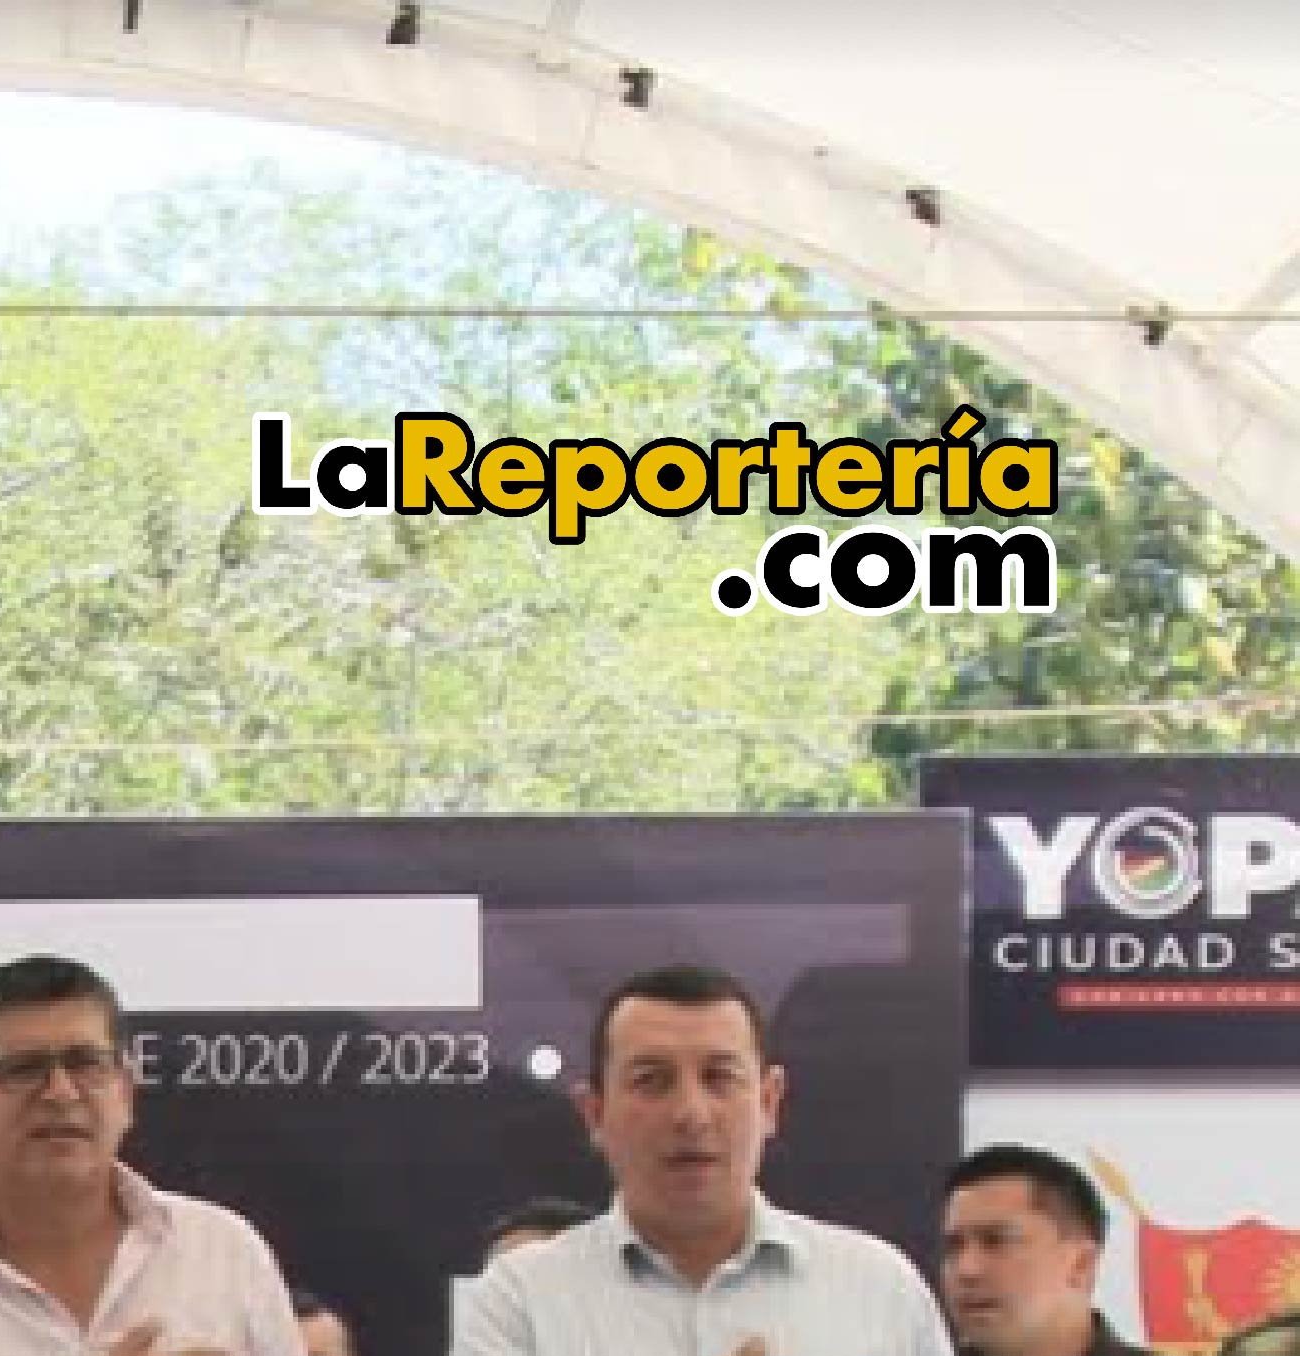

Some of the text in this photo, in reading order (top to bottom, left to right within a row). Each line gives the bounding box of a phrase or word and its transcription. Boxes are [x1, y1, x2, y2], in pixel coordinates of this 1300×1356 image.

[987, 806, 1300, 919] YOP
[993, 931, 1237, 972] CIUDAD
[179, 1032, 308, 1085] 2020
[319, 1031, 348, 1085] /
[361, 1031, 491, 1085] 2023
